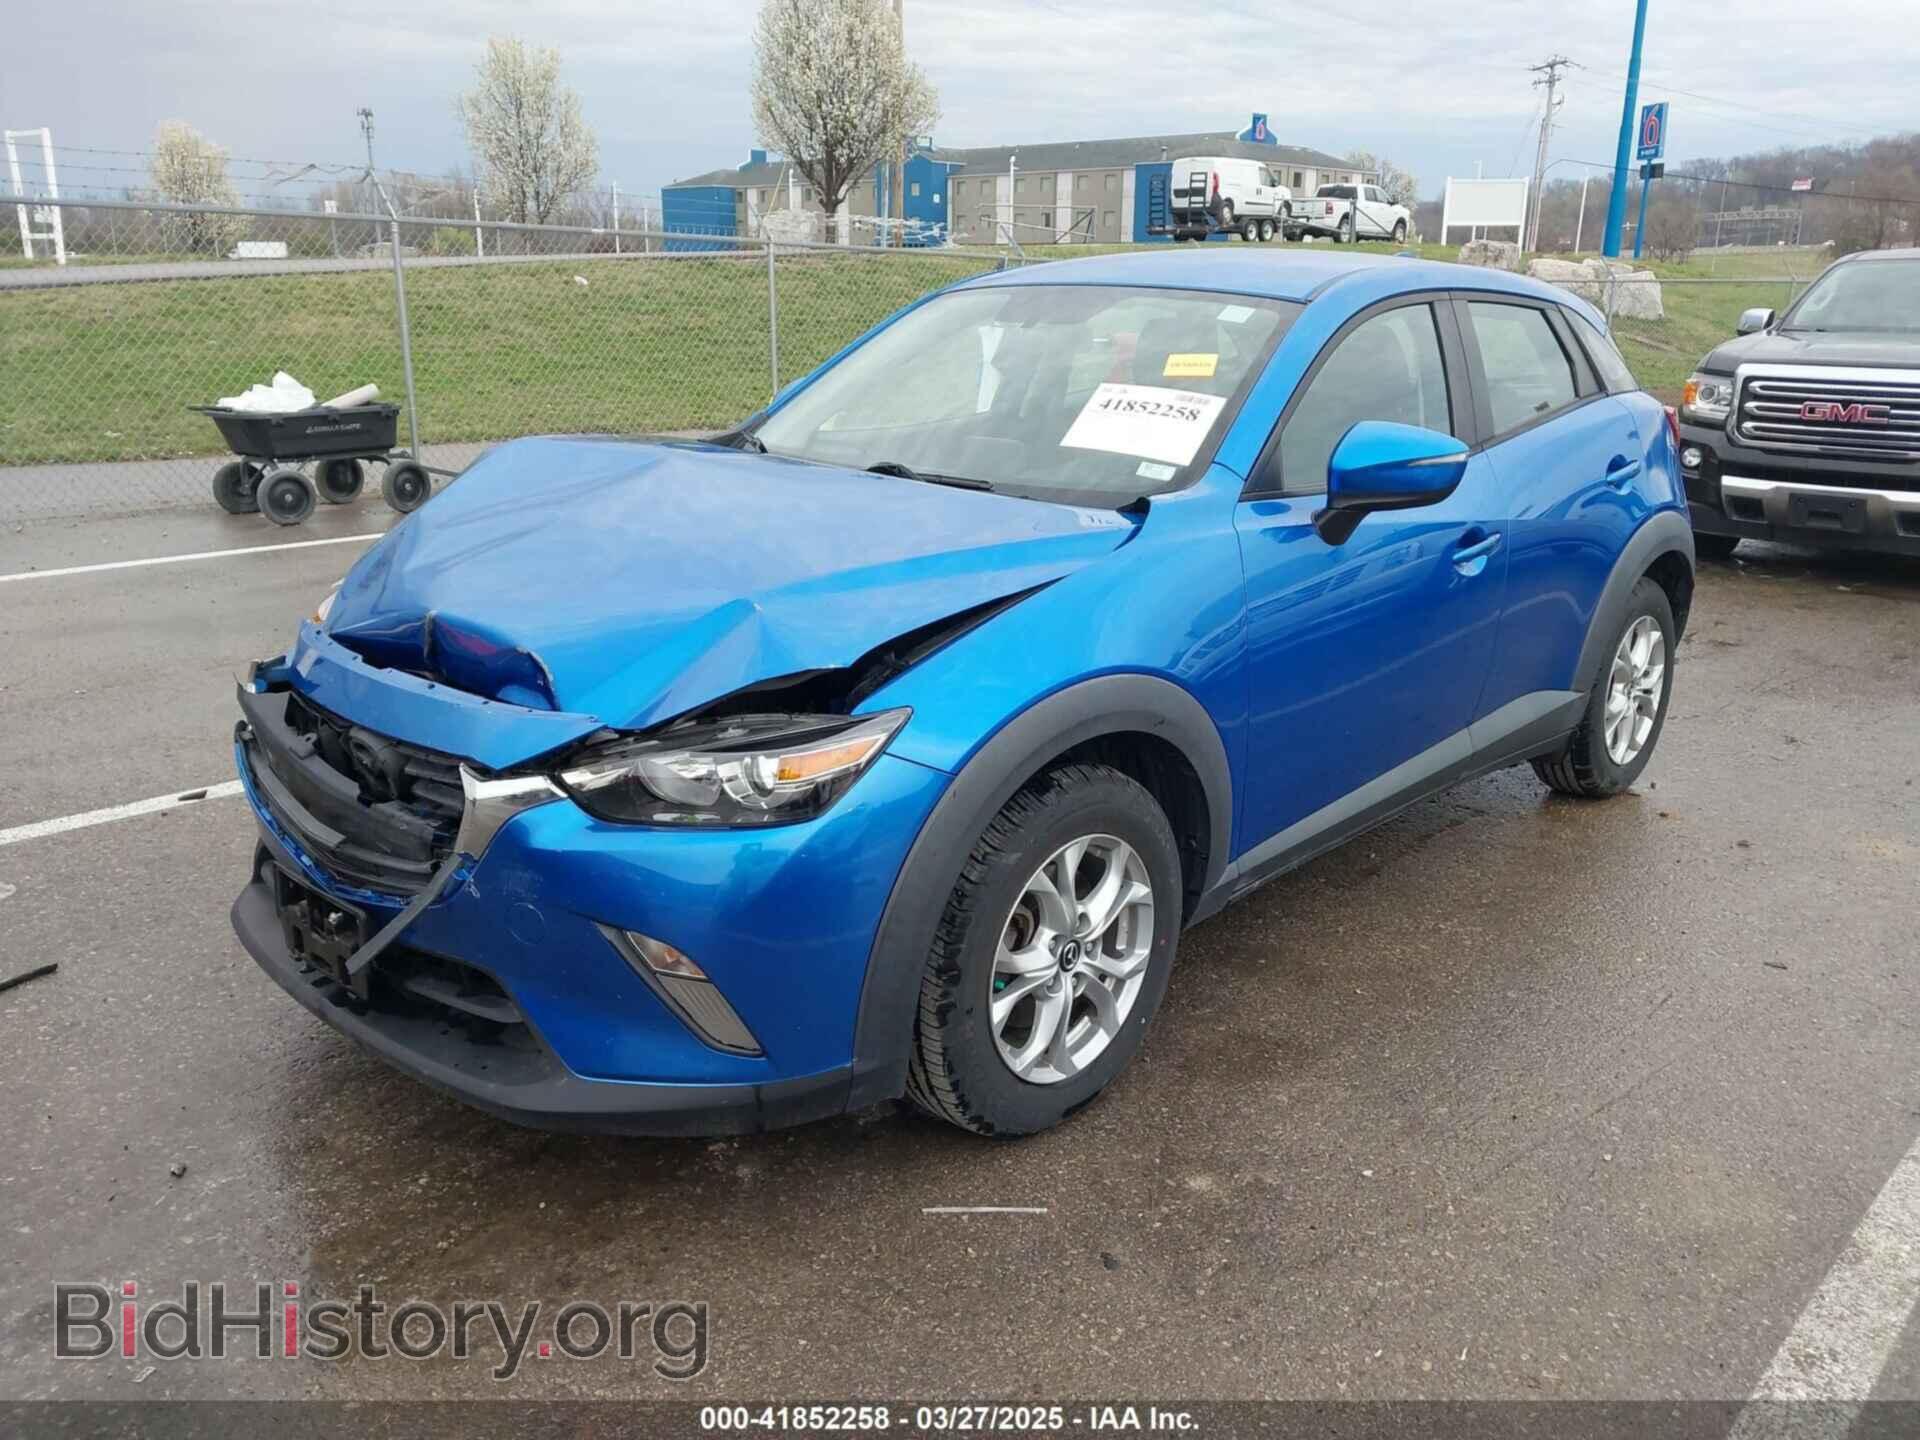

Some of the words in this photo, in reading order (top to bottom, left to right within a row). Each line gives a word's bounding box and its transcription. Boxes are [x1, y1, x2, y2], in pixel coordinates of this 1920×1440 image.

[1644, 104, 1660, 146] 6
[1099, 398, 1201, 421] 41852258
[1799, 400, 1891, 424] GMC
